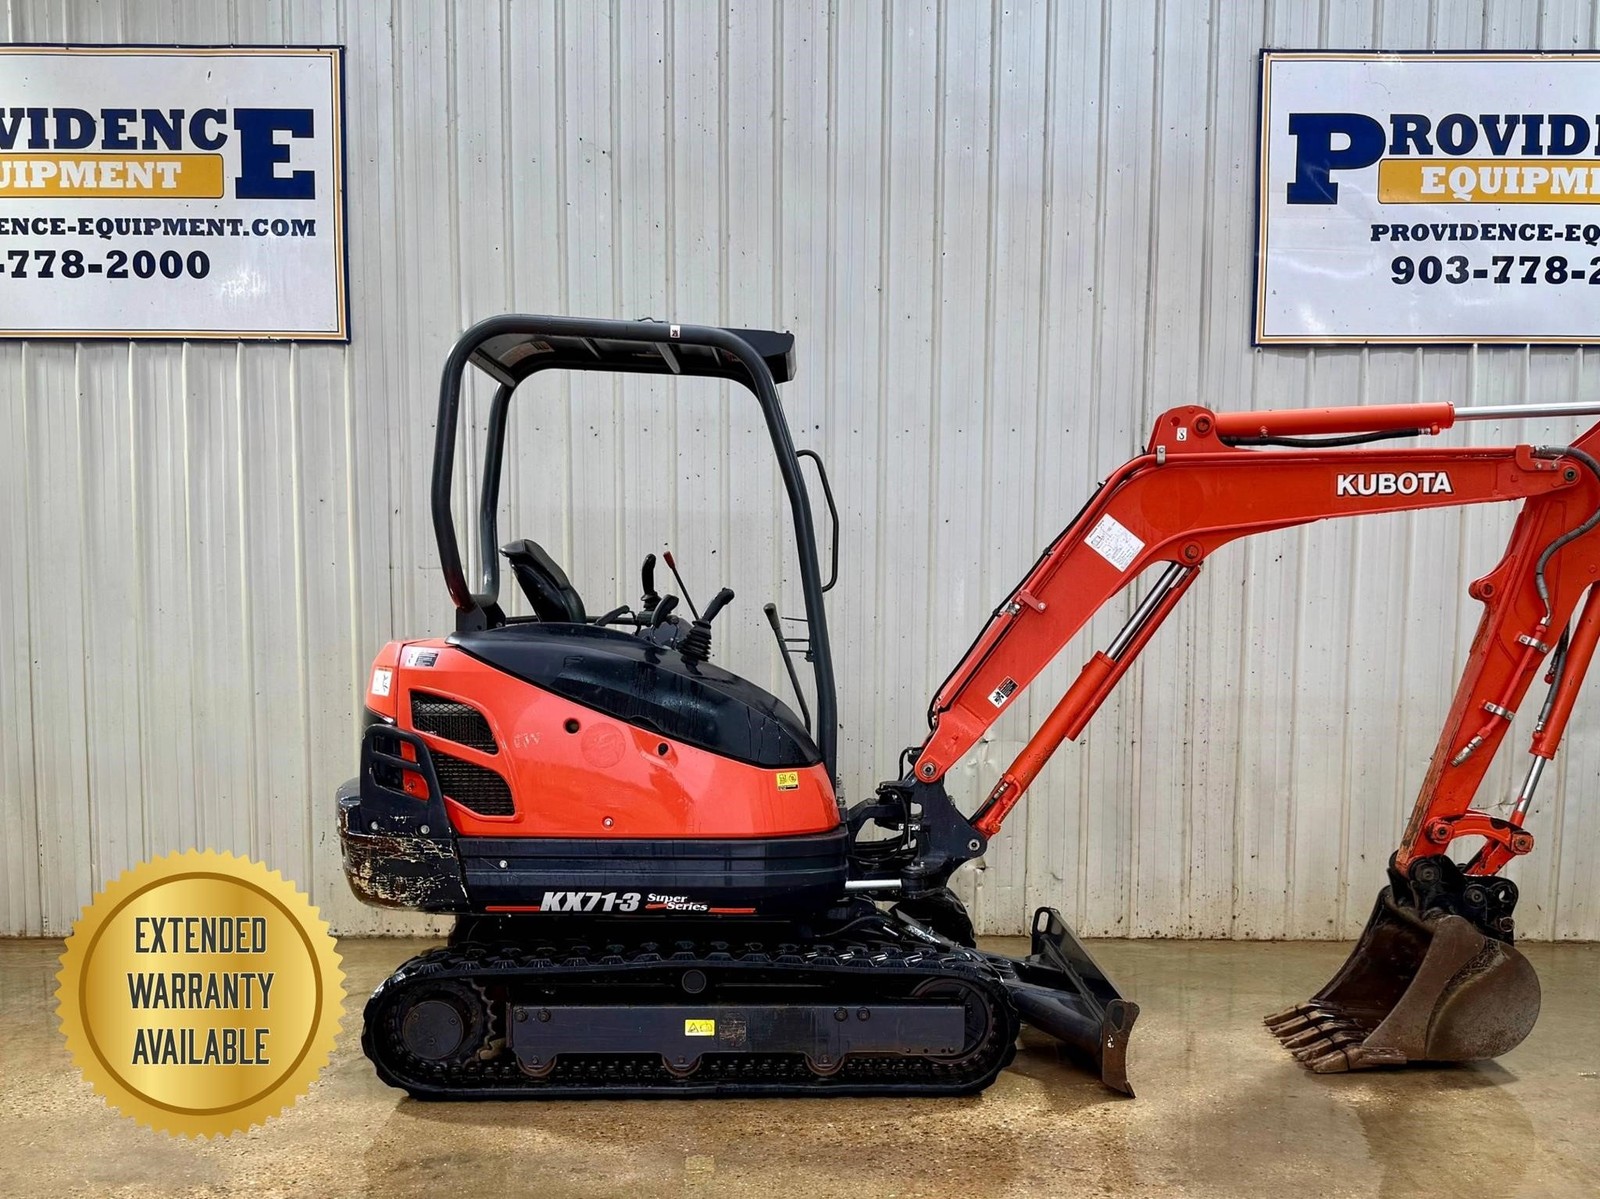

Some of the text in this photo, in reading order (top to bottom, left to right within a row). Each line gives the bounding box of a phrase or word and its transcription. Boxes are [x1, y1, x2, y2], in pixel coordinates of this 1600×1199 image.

[1287, 113, 1600, 205] PROVID
[1370, 223, 1600, 246] PROVIDENCE-EQ
[1336, 471, 1453, 496] KUBOTA
[540, 891, 641, 912] KX71-3
[647, 893, 688, 904] Super
[666, 902, 708, 911] Series
